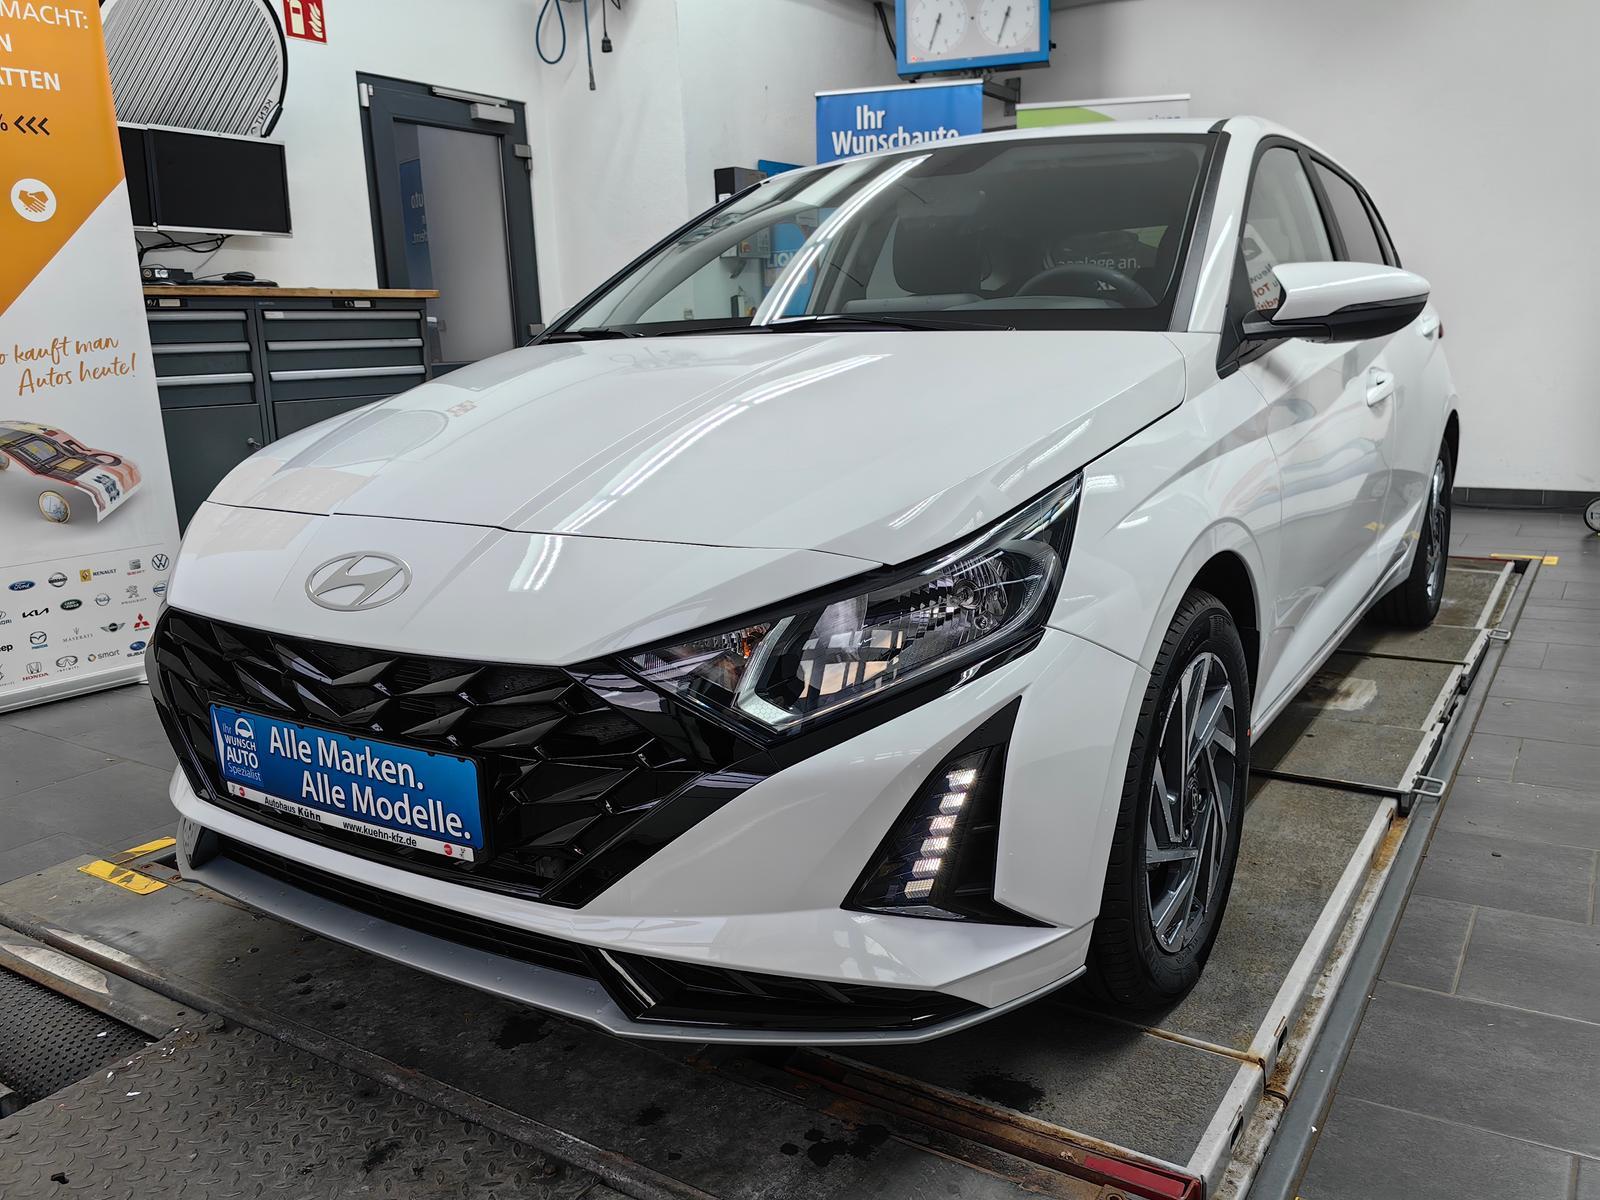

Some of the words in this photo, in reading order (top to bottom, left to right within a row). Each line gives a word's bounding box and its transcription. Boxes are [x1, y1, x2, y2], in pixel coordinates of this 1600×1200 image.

[255, 99, 273, 124] KENT
[856, 104, 885, 130] Ihr
[1119, 258, 1141, 269] an.
[15, 336, 71, 365] kauft
[75, 337, 119, 355] man
[18, 367, 72, 396] Autos
[79, 352, 136, 382] heute!
[22, 607, 49, 619] KIA
[97, 649, 120, 660] smart
[22, 672, 49, 682] HONDA
[222, 723, 232, 735] Ihr
[224, 734, 257, 752] WUNSCH
[227, 746, 259, 769] AUTO
[270, 726, 312, 764] Alle
[317, 736, 424, 790] Marken.
[228, 762, 262, 782] Spezialist
[264, 796, 296, 814] Autohaus
[298, 806, 321, 822] Kühn
[301, 770, 346, 809] Alle
[352, 782, 471, 840] Modelle.
[342, 821, 417, 846] www.kuehn-kfz.de
